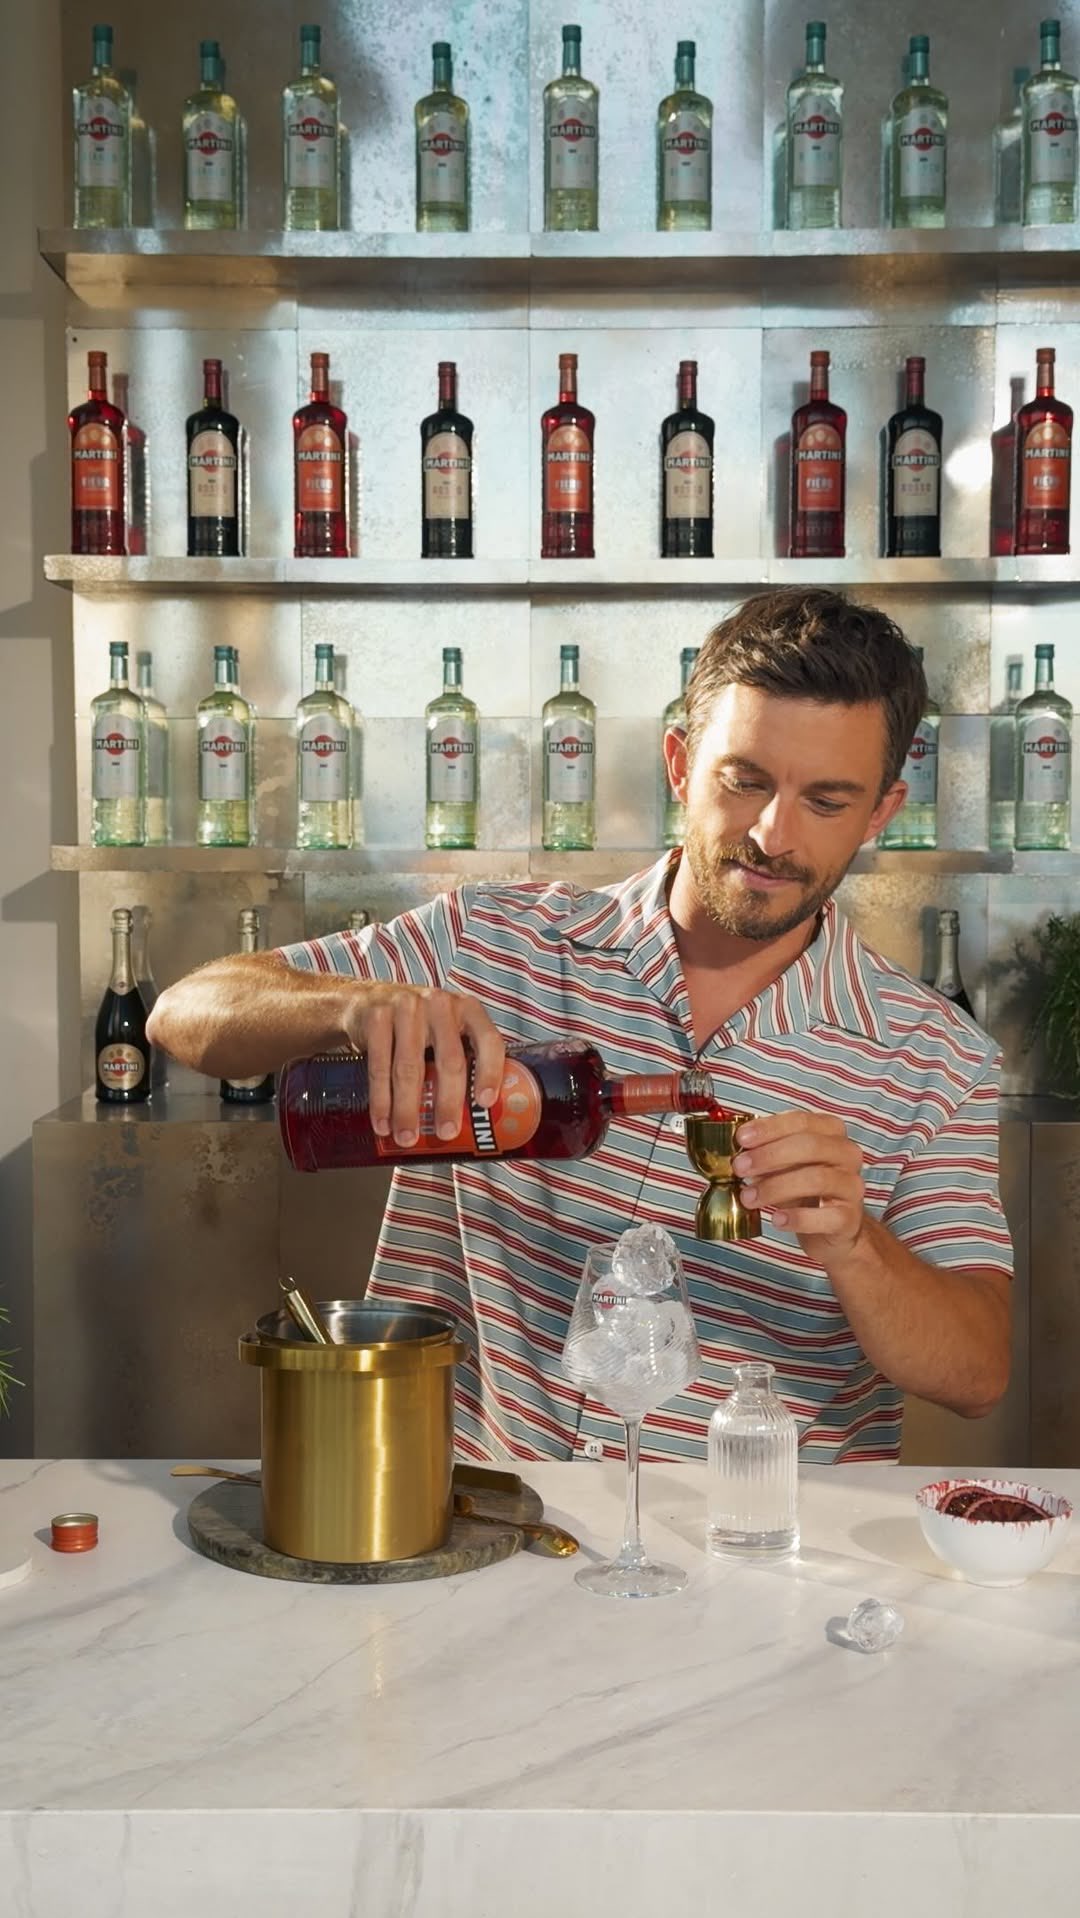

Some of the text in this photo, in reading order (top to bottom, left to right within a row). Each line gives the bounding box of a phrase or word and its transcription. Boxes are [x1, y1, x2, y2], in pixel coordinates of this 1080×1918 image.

[79, 125, 123, 136] MARTINI
[290, 125, 334, 136] MARTINI
[794, 123, 839, 134] MARTINI
[1032, 120, 1077, 131] MARTINI
[551, 126, 594, 137] MARTINI
[189, 139, 232, 150] MARTINI
[665, 139, 708, 150] MARTINI
[902, 135, 944, 145] MARTINI
[421, 140, 464, 151] MARTINI
[74, 449, 116, 459] MARTINI
[298, 452, 341, 461] MARTINI
[547, 452, 590, 462] MARTINI
[799, 451, 842, 461] MARTINI
[1025, 448, 1070, 458] MARTINI
[191, 456, 234, 467] MARTINI
[426, 458, 468, 469] MARTINI
[667, 458, 710, 468] MARTINI
[895, 455, 938, 465] MARTINI
[96, 739, 139, 749] MARTINI
[203, 742, 245, 752] MARTINI
[303, 741, 345, 751] MARTINI
[432, 743, 473, 753] MARTINI
[550, 743, 592, 753] MARTINI
[1025, 742, 1068, 752] MARTINI
[104, 1062, 138, 1072] MARTINI
[593, 1293, 626, 1305] MARTINI
